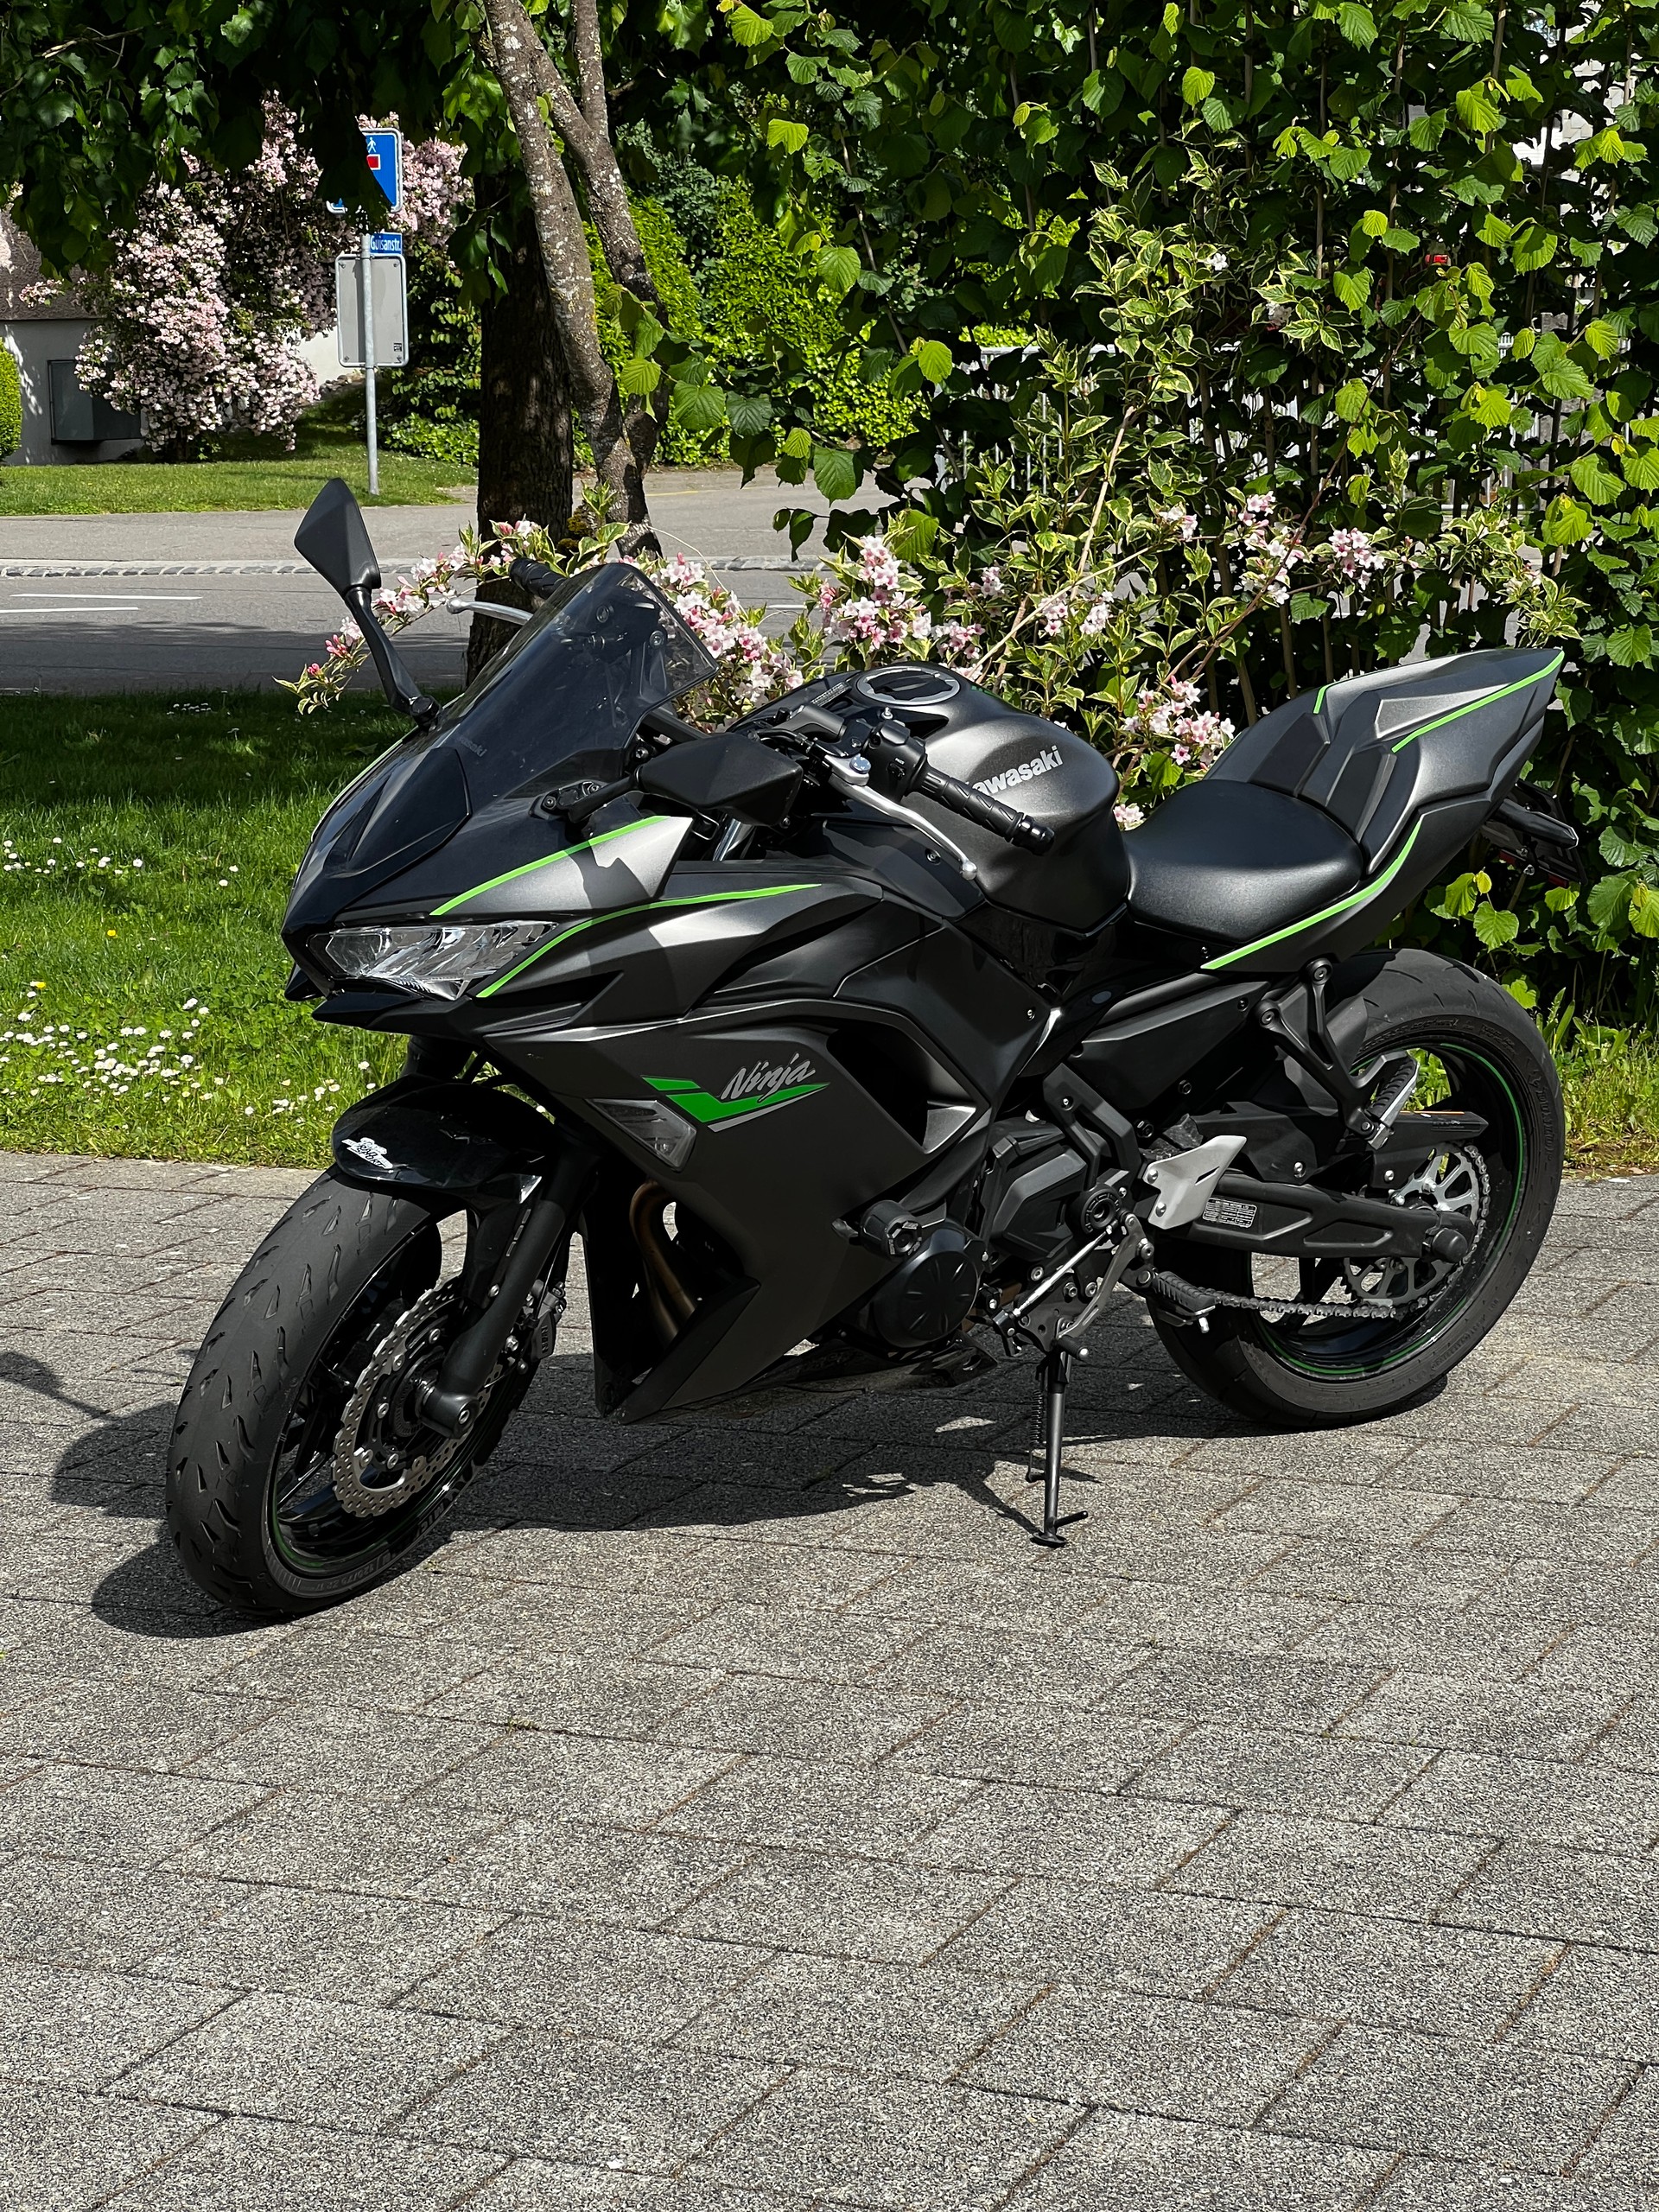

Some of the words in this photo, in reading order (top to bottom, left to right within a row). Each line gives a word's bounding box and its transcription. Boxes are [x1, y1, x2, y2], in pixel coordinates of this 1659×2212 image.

[371, 235, 401, 251] Guisanstr.
[965, 745, 1064, 796] awasaki
[721, 1052, 816, 1103] Ninja
